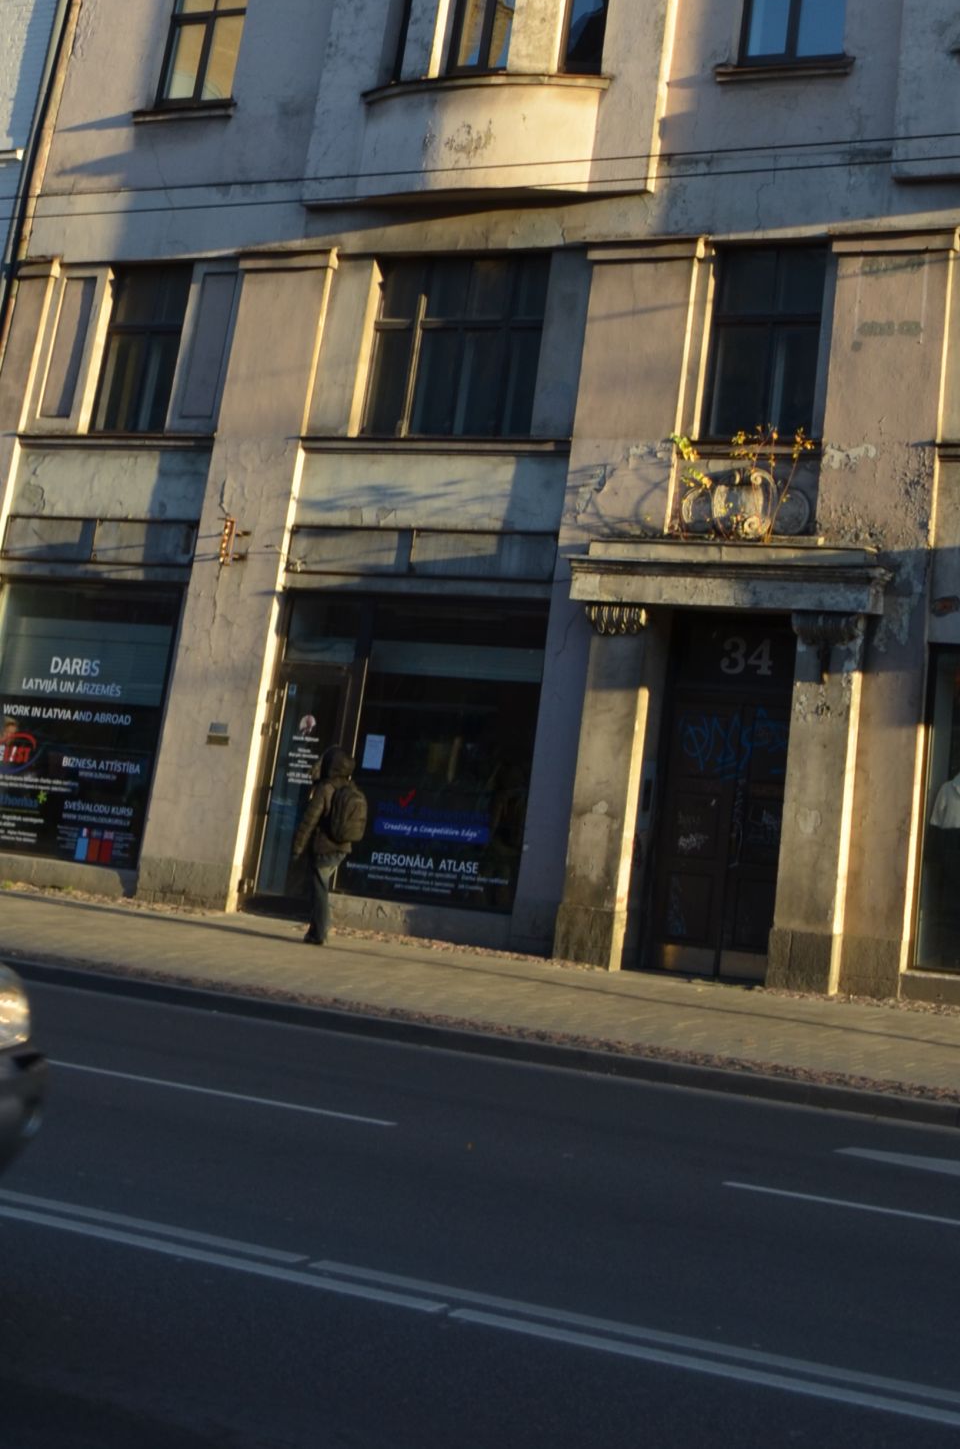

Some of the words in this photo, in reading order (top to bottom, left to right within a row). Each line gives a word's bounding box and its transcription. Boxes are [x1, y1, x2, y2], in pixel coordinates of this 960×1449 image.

[50, 656, 100, 677] DARBS
[720, 636, 773, 676] 34
[22, 677, 58, 693] LATVIJĀ
[60, 681, 75, 694] UN
[75, 680, 122, 697] ĀRZEMĒS
[3, 703, 31, 717] WORK
[31, 706, 41, 718] IN
[42, 707, 72, 720] LATVIA
[72, 710, 92, 723] AND
[93, 712, 132, 726] ABROAD
[61, 755, 98, 769] BIZNESA
[110, 806, 134, 817] KURSI
[370, 851, 434, 869] PERSONĀLA
[438, 858, 480, 874] ATLASE
